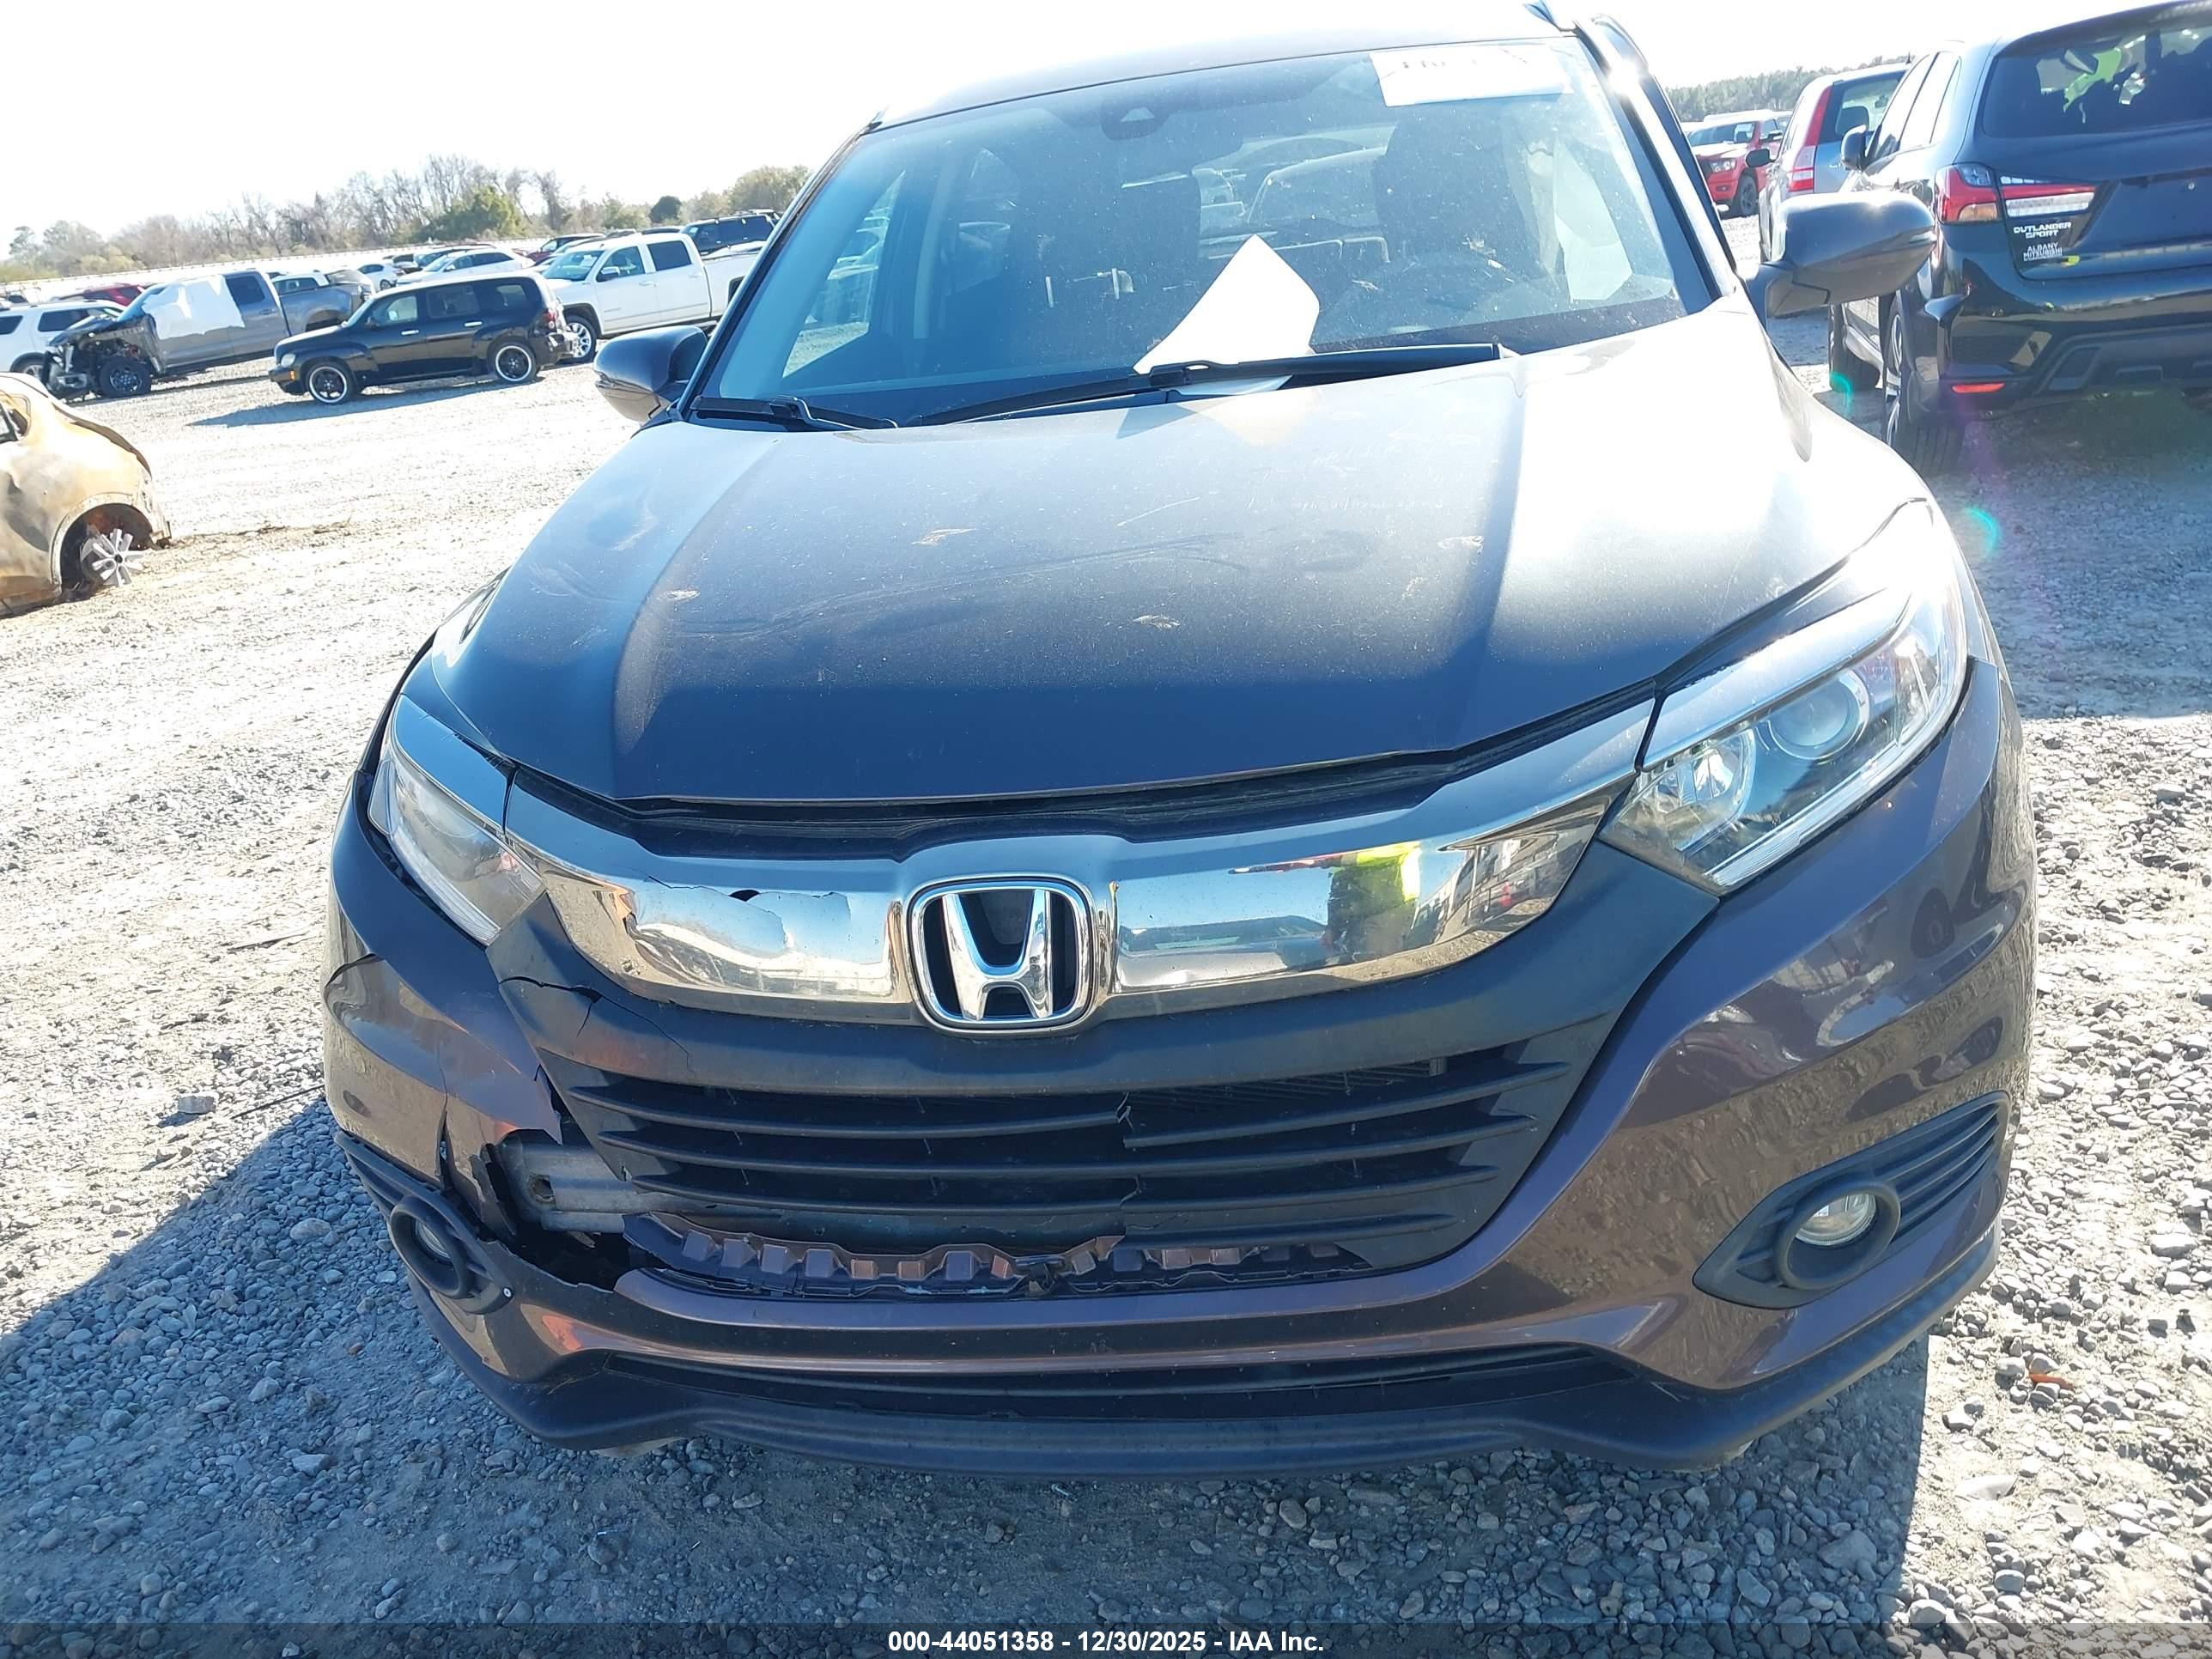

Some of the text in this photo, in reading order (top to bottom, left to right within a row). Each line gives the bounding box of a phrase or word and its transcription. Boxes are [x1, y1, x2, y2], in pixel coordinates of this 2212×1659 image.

[2013, 222, 2072, 234] OUTLANDER
[2025, 229, 2059, 238] SPORT
[2027, 242, 2058, 253] ALBANY
